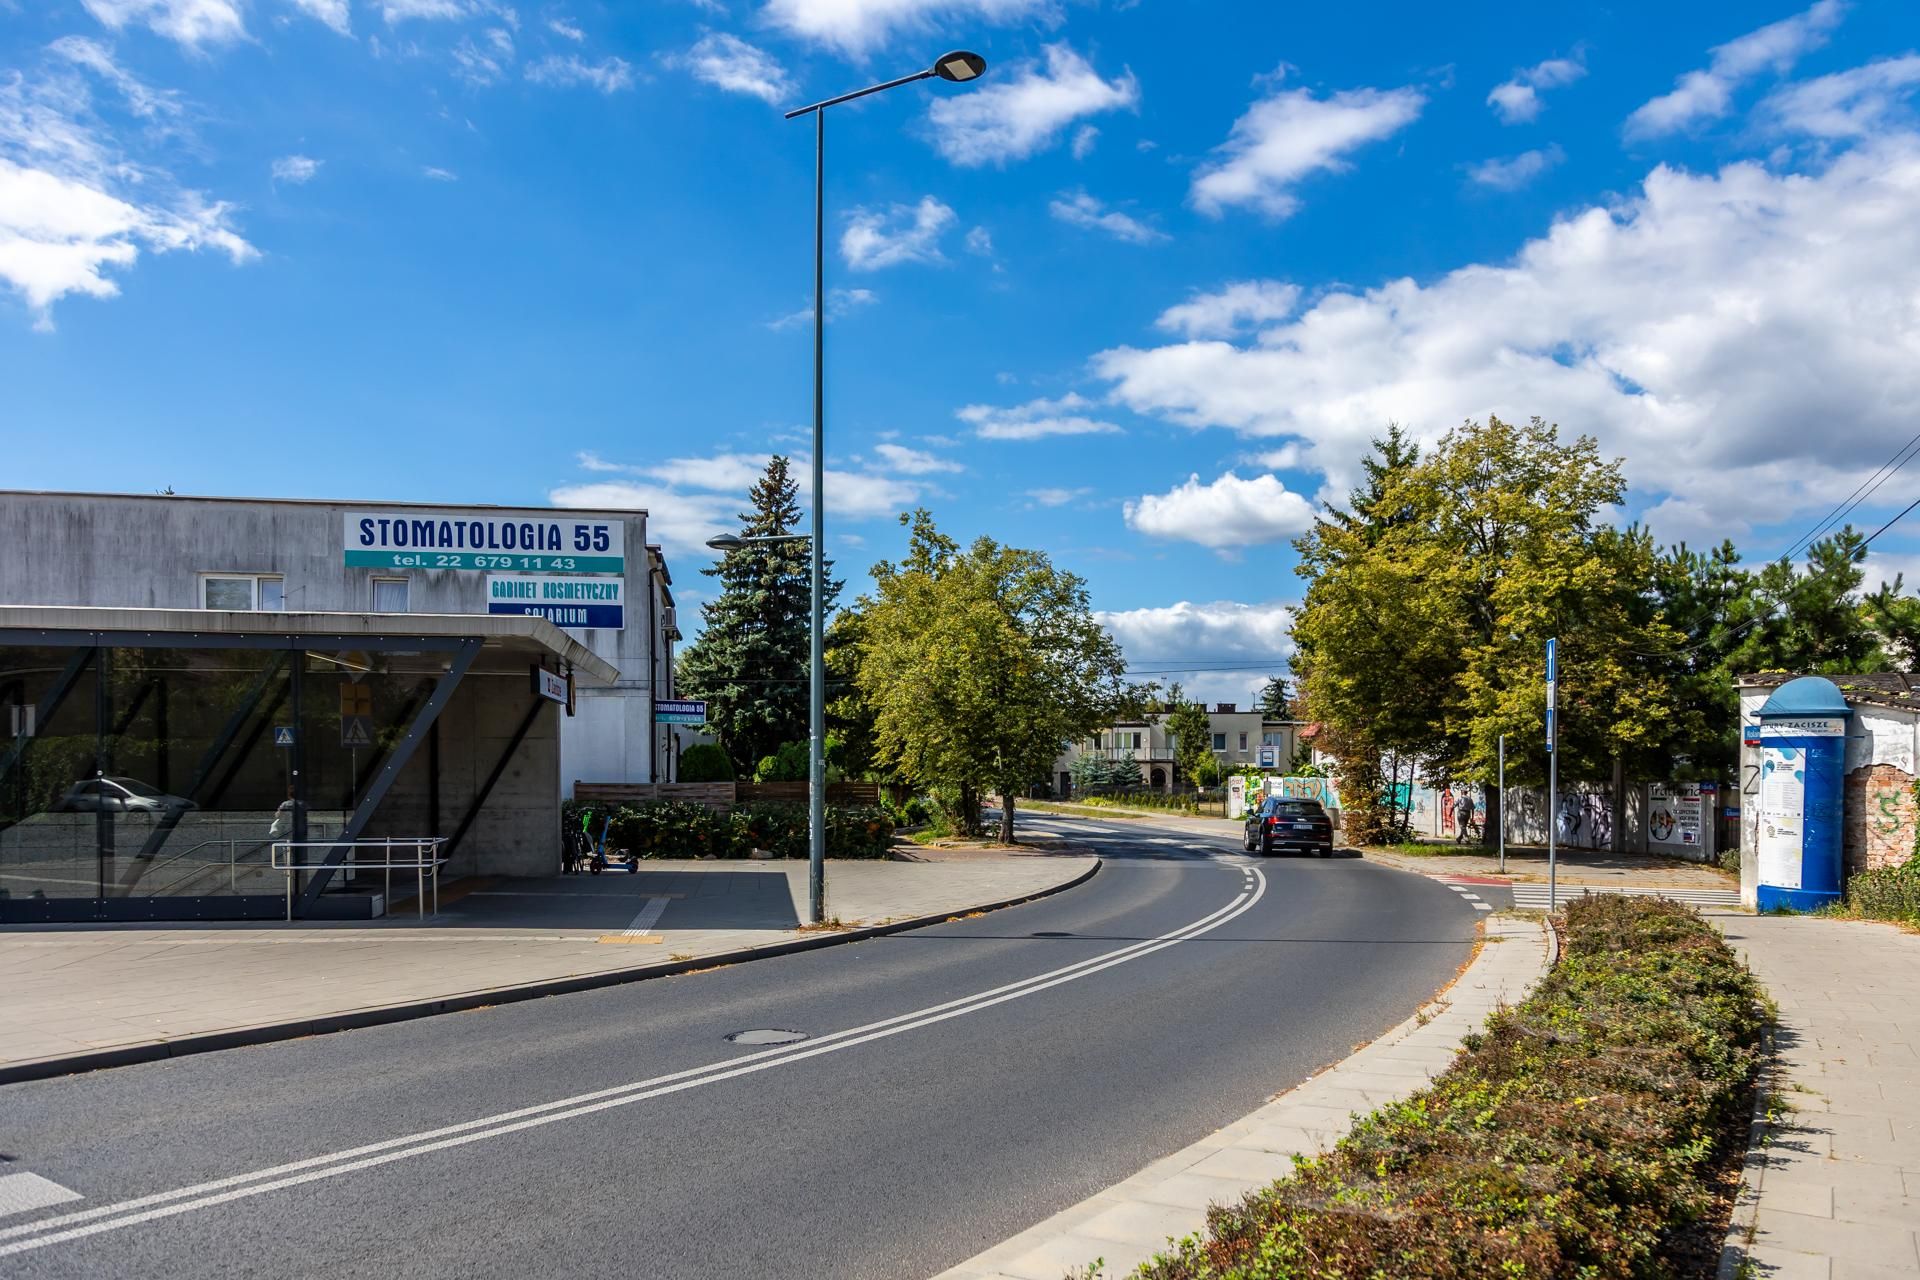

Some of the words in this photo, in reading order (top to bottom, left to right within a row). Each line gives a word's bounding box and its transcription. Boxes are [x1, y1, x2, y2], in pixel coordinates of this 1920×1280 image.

[360, 518, 561, 551] STOMATOLOGIA
[574, 525, 610, 551] 55
[393, 554, 427, 566] tel.
[436, 555, 462, 567] 22
[474, 556, 512, 569] 679
[520, 557, 542, 569] 11
[551, 558, 576, 569] 43
[492, 580, 537, 599] GABINET
[543, 582, 619, 600] KOSMETYCZNY
[696, 704, 704, 713] 55
[1788, 721, 1828, 729] ZACISZE
